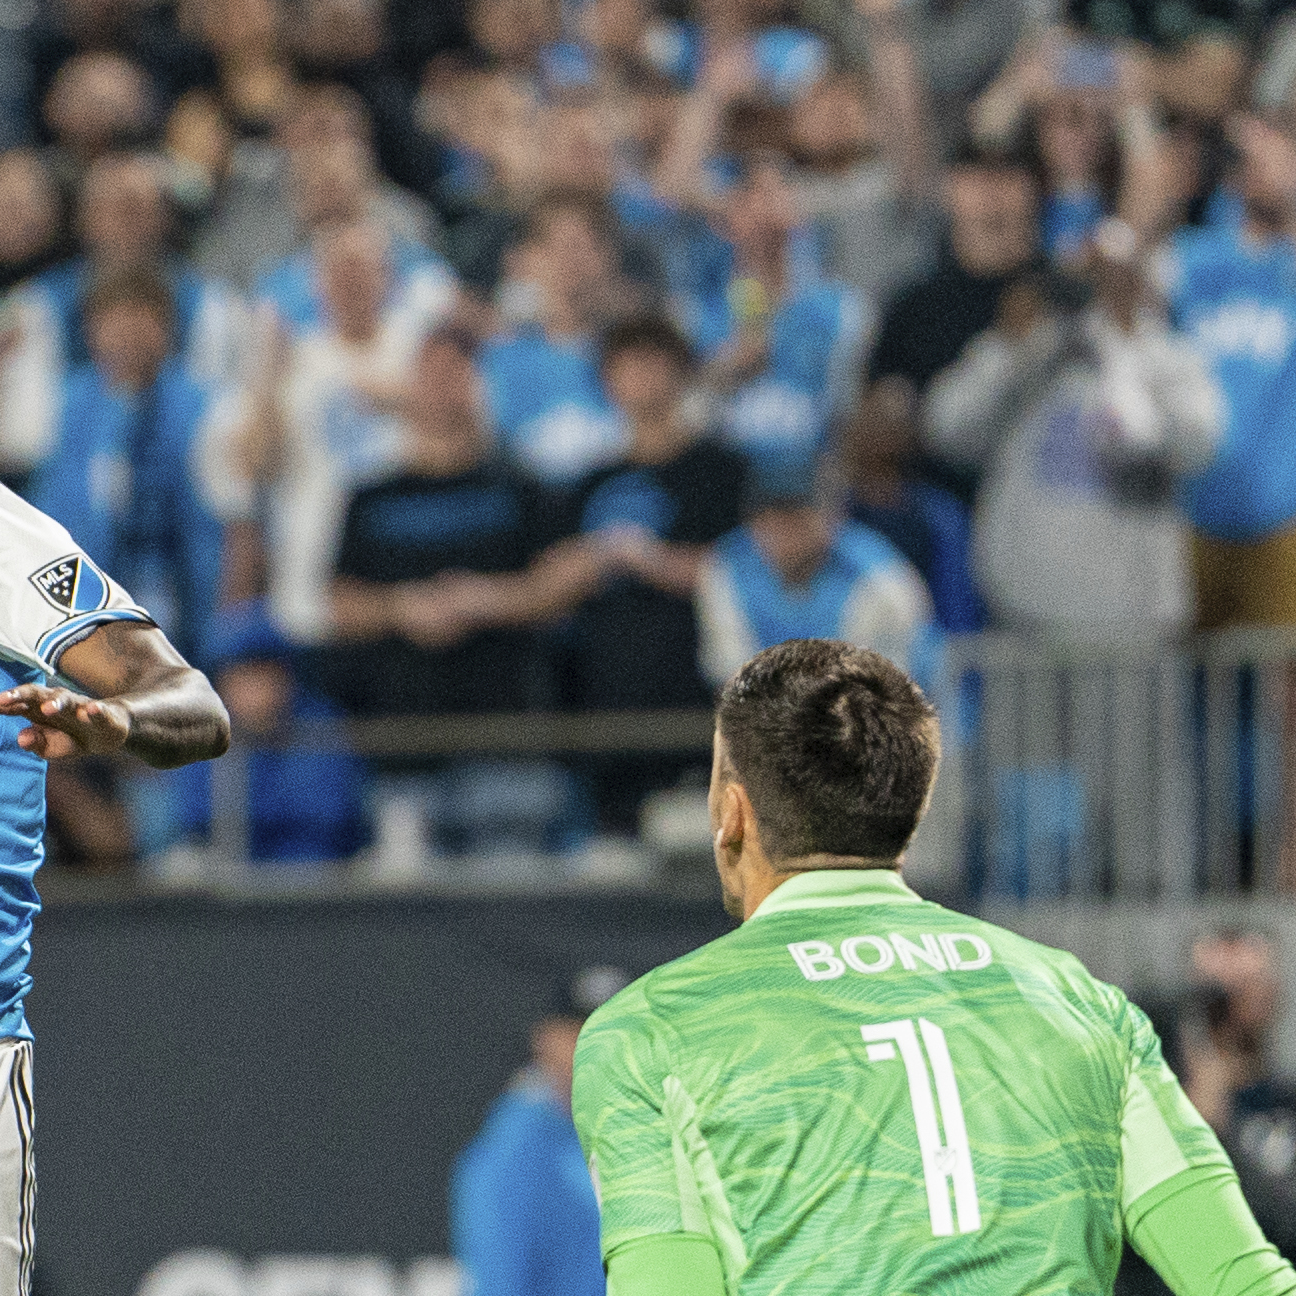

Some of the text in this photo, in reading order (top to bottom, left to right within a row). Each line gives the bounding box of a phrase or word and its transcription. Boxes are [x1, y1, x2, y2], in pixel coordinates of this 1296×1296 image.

[38, 563, 74, 590] MLS
[786, 932, 993, 982] BOND
[859, 1016, 982, 1237] 1
